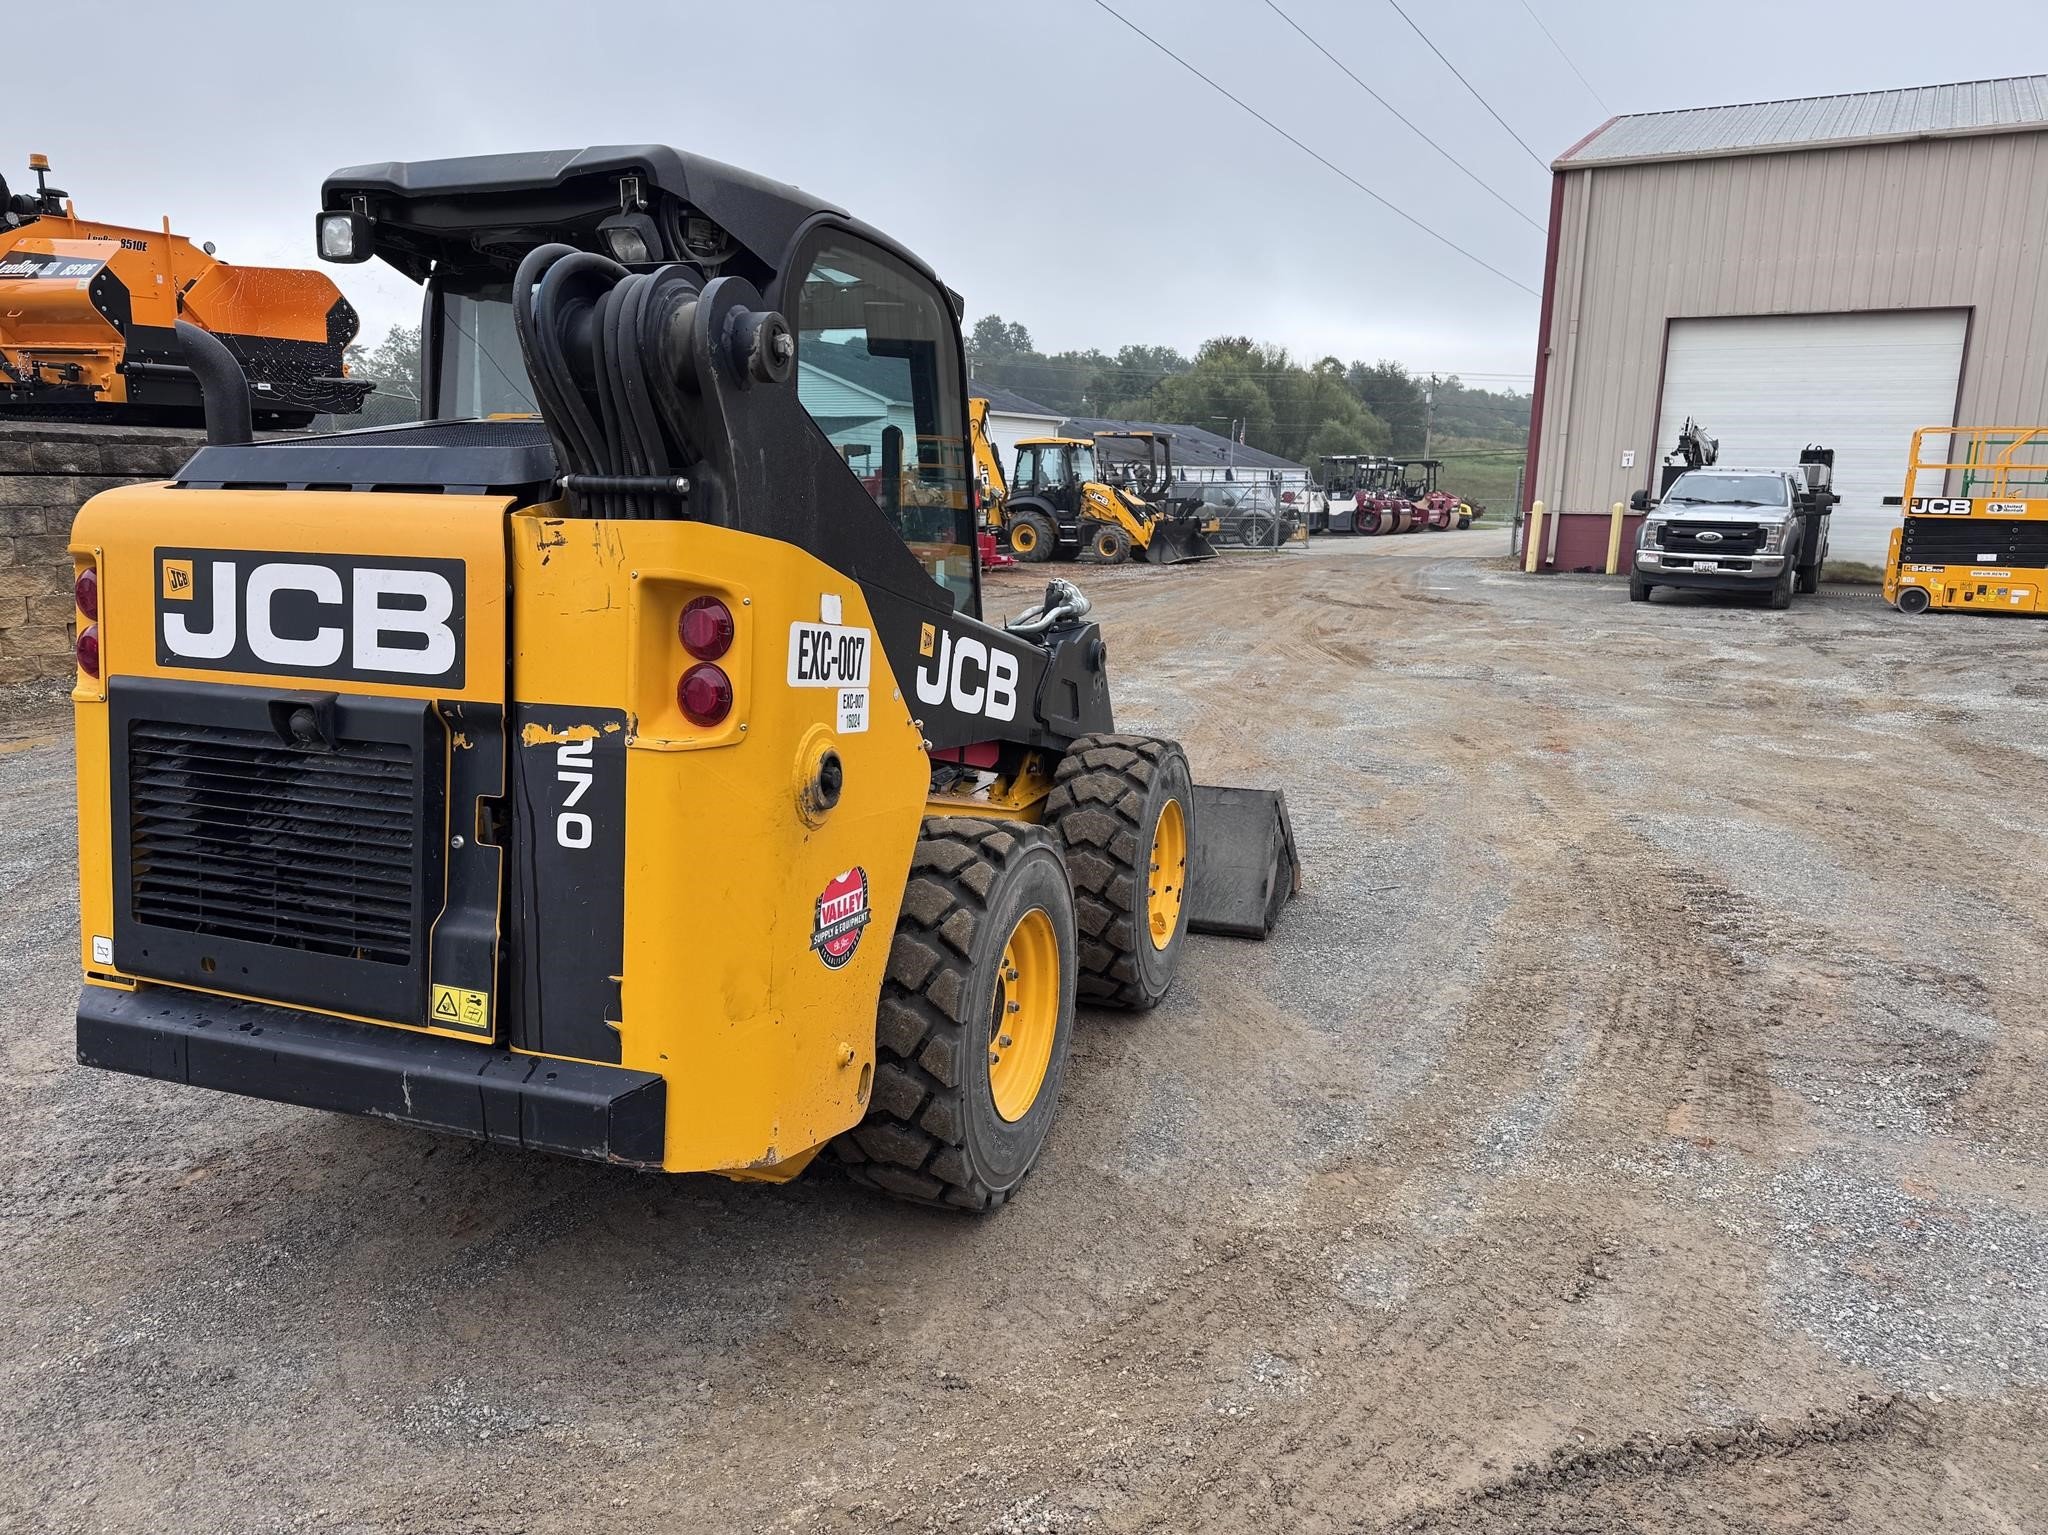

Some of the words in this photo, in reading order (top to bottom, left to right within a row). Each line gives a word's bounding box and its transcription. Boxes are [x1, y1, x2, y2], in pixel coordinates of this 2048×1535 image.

[120, 239, 147, 251] 8510E
[1090, 493, 1109, 506] JCB
[1910, 499, 1971, 514] JCB
[170, 570, 188, 589] JCB
[163, 561, 457, 675] JCB
[798, 629, 865, 681] EXC-007
[916, 629, 1019, 722] JCB
[843, 693, 865, 709] EXC-007
[557, 730, 593, 849] 270
[821, 891, 863, 926] VALLEY
[813, 928, 835, 945] SUPPLY
[834, 925, 839, 935] &
[839, 912, 868, 934] EQUIPMENT
